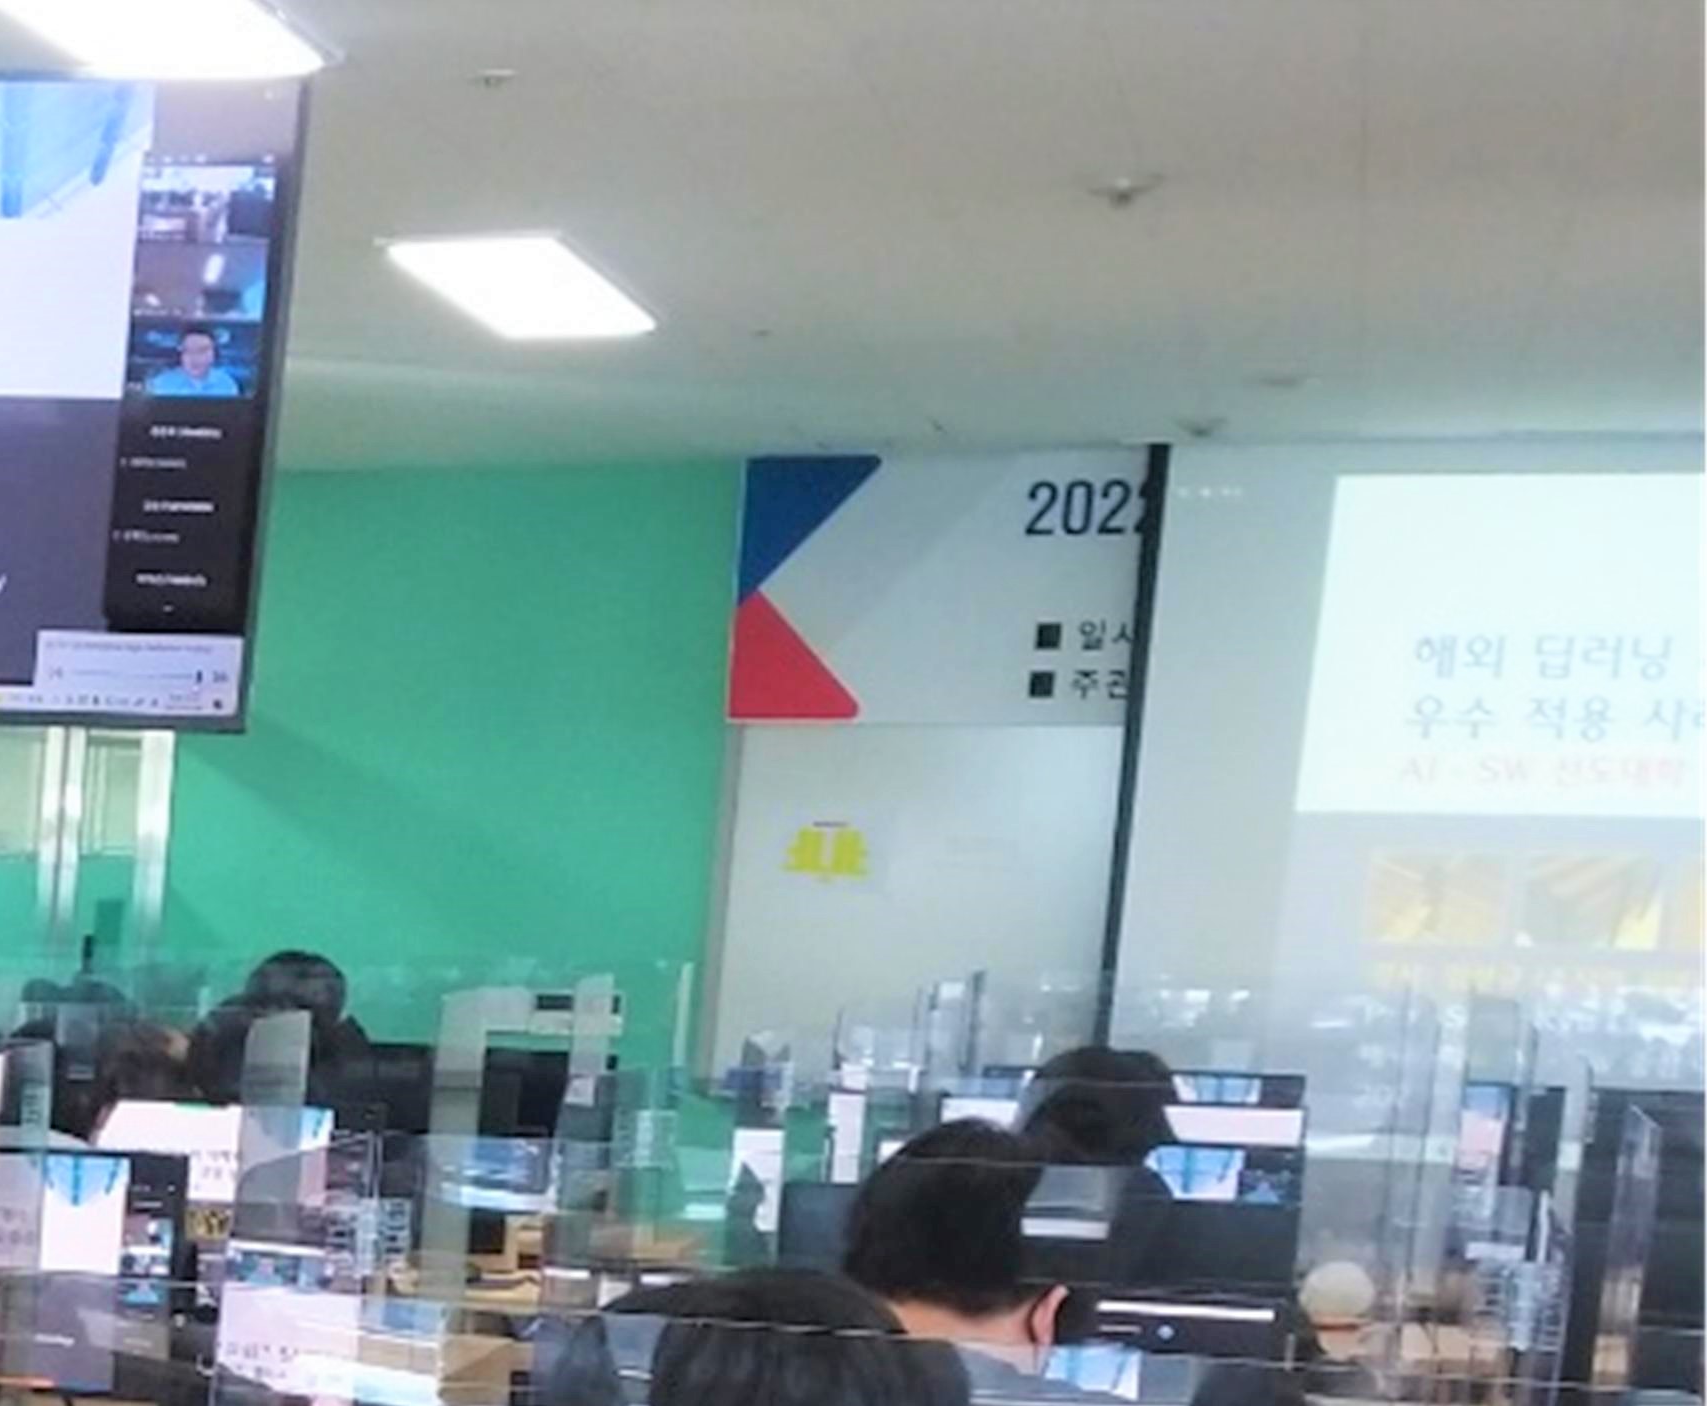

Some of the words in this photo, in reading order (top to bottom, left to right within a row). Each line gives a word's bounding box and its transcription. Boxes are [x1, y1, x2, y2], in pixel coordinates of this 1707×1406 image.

[1413, 633, 1508, 680] 해외
[1533, 633, 1675, 682] 딥러닝
[1403, 693, 1498, 741] 우수
[1523, 694, 1618, 744] 적용
